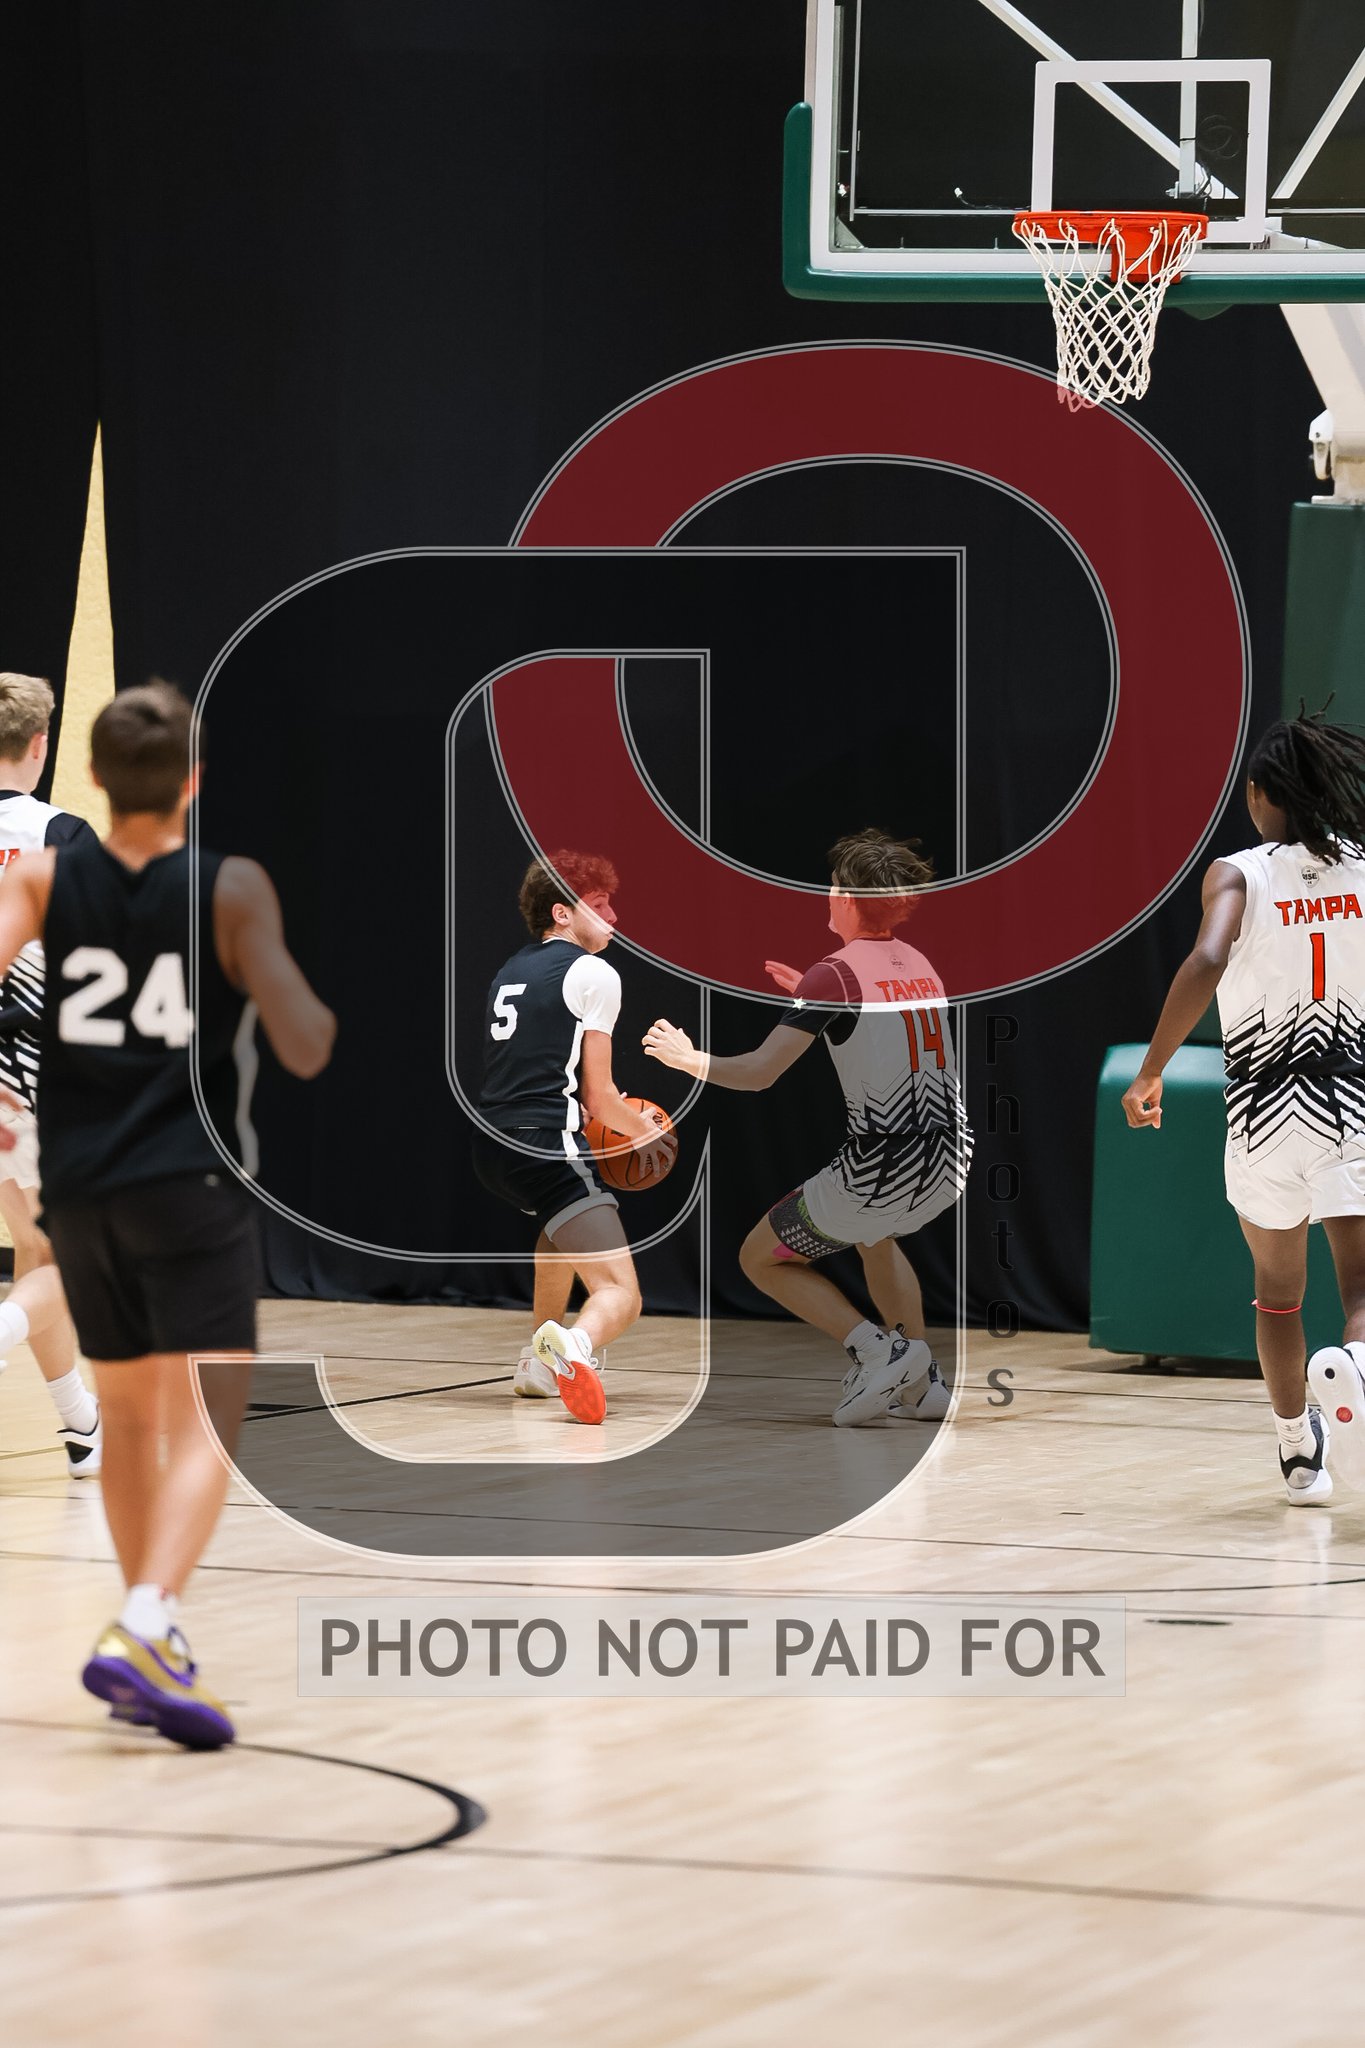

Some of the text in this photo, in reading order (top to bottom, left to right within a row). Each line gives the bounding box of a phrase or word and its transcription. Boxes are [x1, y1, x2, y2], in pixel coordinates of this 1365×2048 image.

[1274, 893, 1363, 926] TAMPA
[58, 946, 195, 1048] 24
[874, 977, 941, 1003] TAMPA
[1309, 932, 1326, 1001] 1
[490, 983, 528, 1041] 5
[898, 1006, 946, 1073] 14
